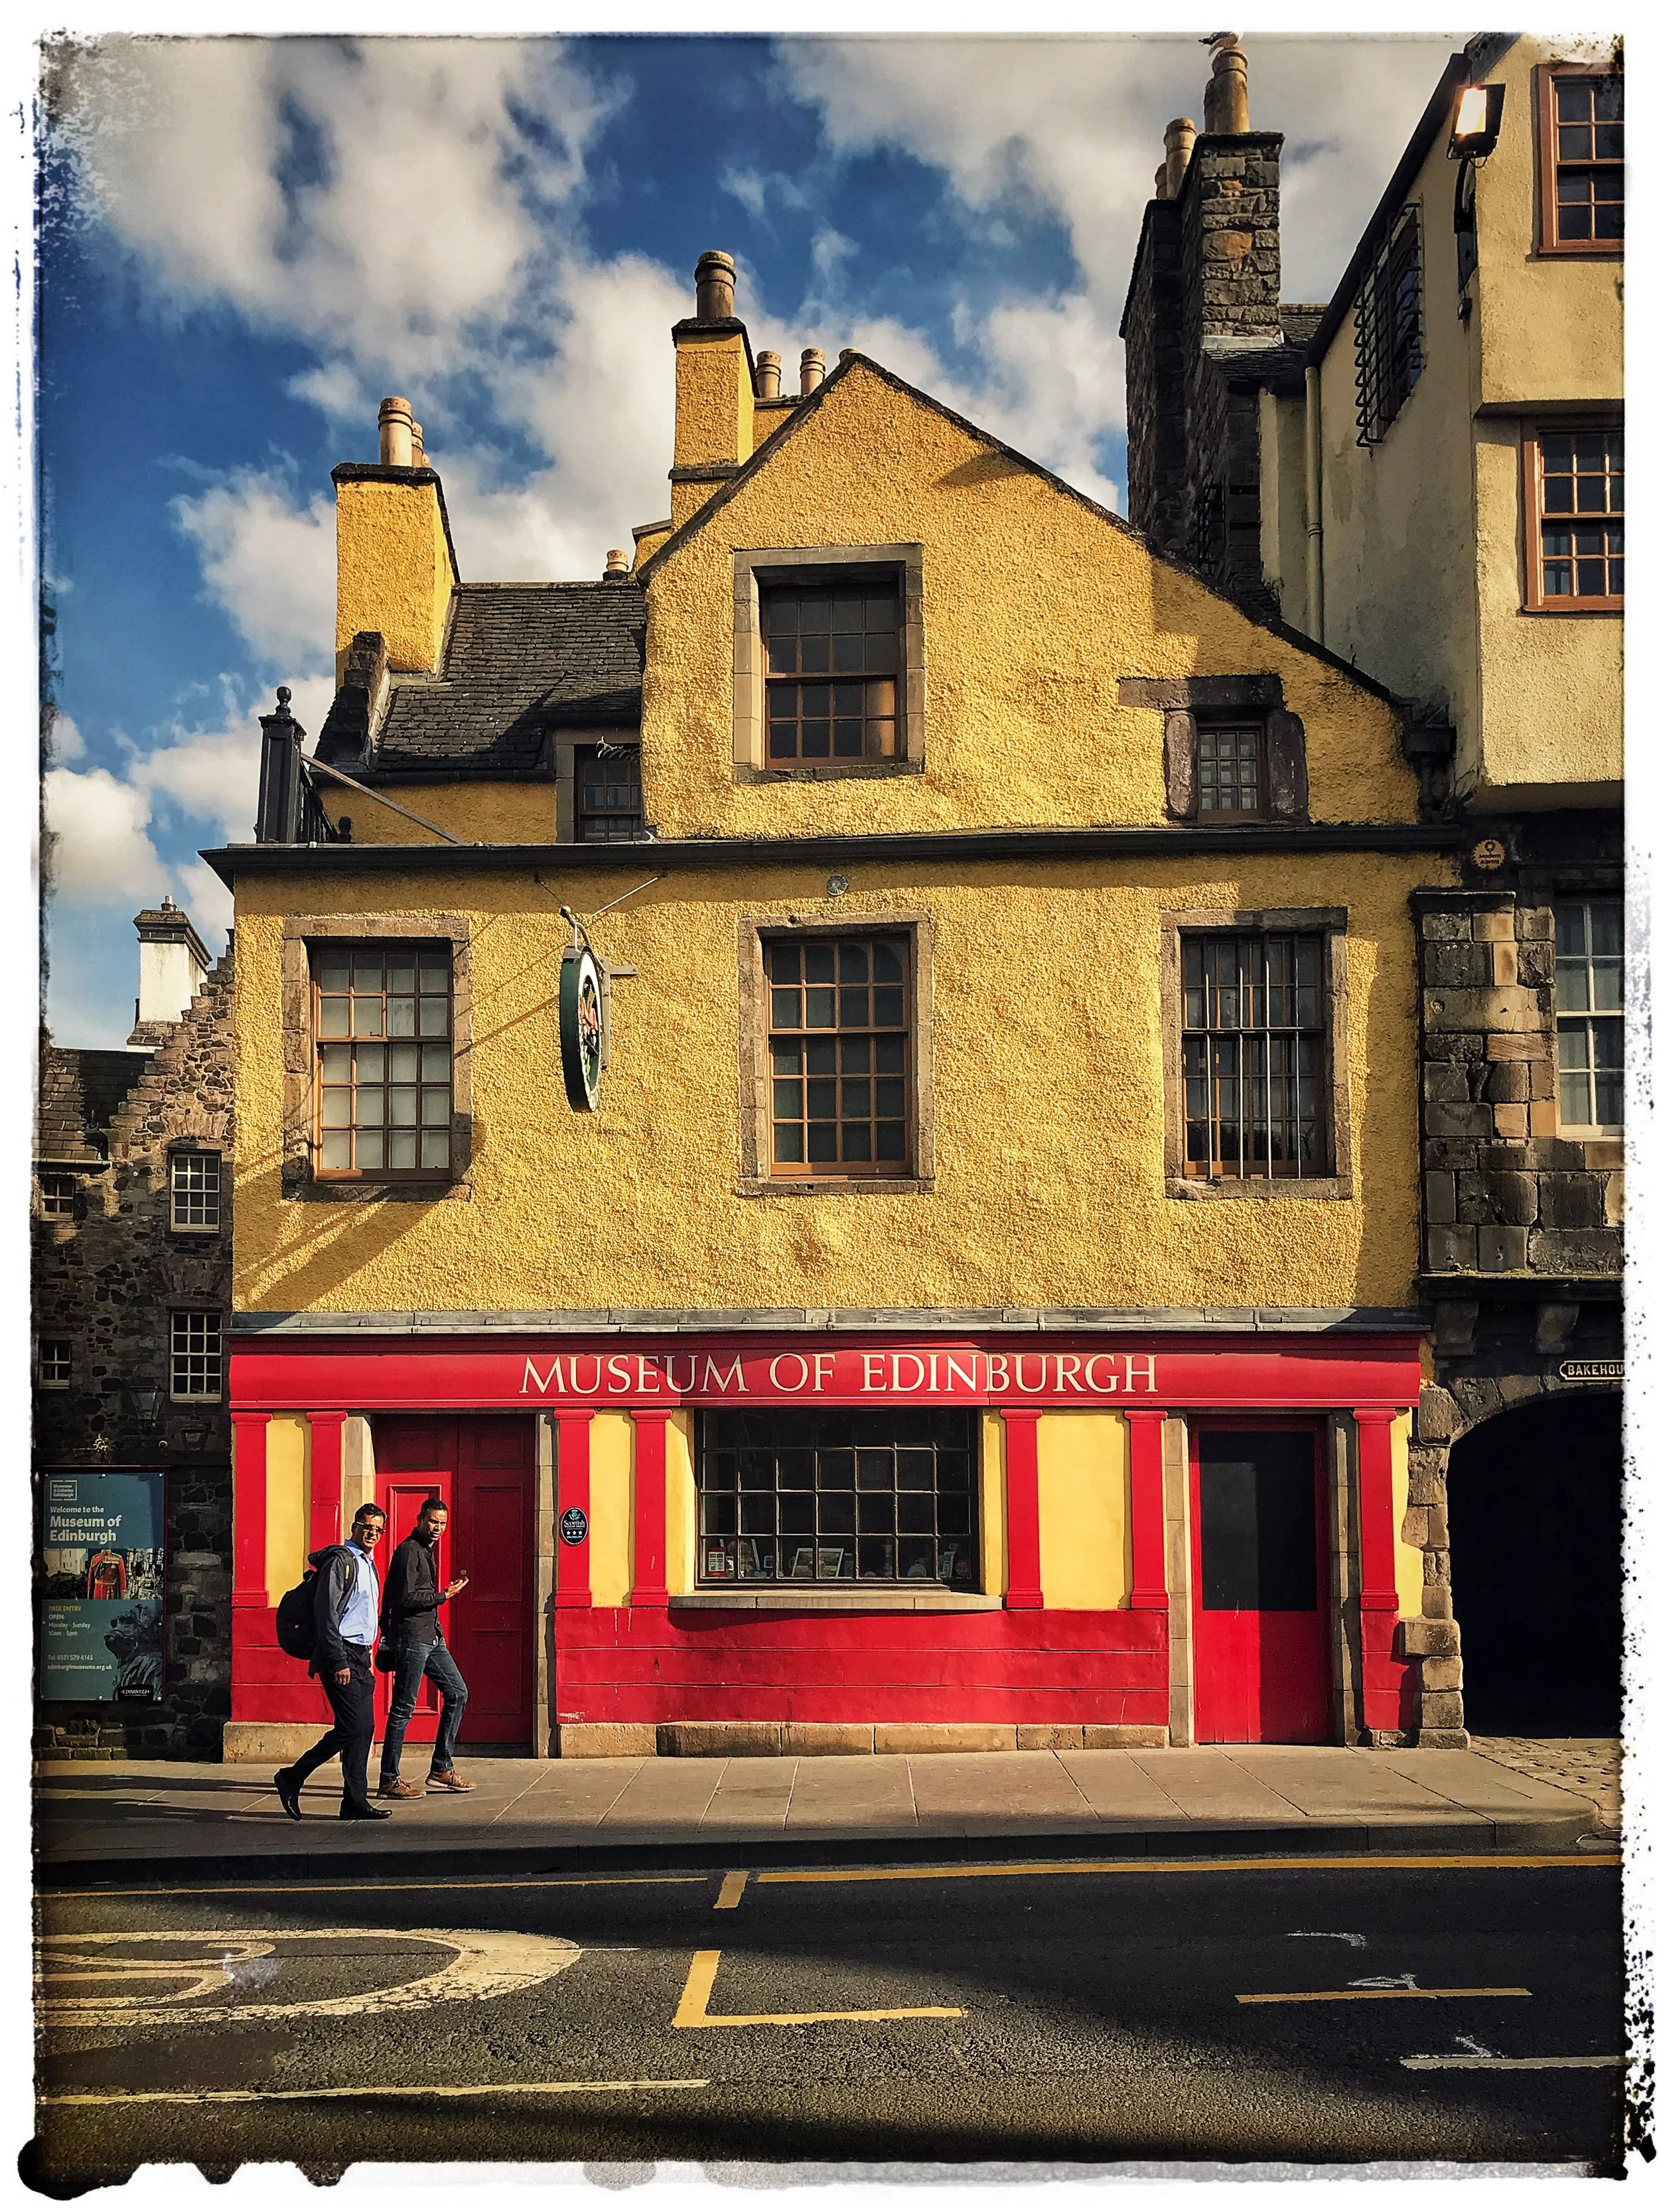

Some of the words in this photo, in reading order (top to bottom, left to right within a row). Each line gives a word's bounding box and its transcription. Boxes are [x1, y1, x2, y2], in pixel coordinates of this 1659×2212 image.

[519, 1354, 749, 1394] MUSEUM
[769, 1353, 835, 1392] OF
[860, 1353, 1159, 1393] EDINBURGH
[50, 1515, 105, 1528] Museum
[107, 1514, 122, 1527] of
[50, 1529, 117, 1545] Edinburgh
